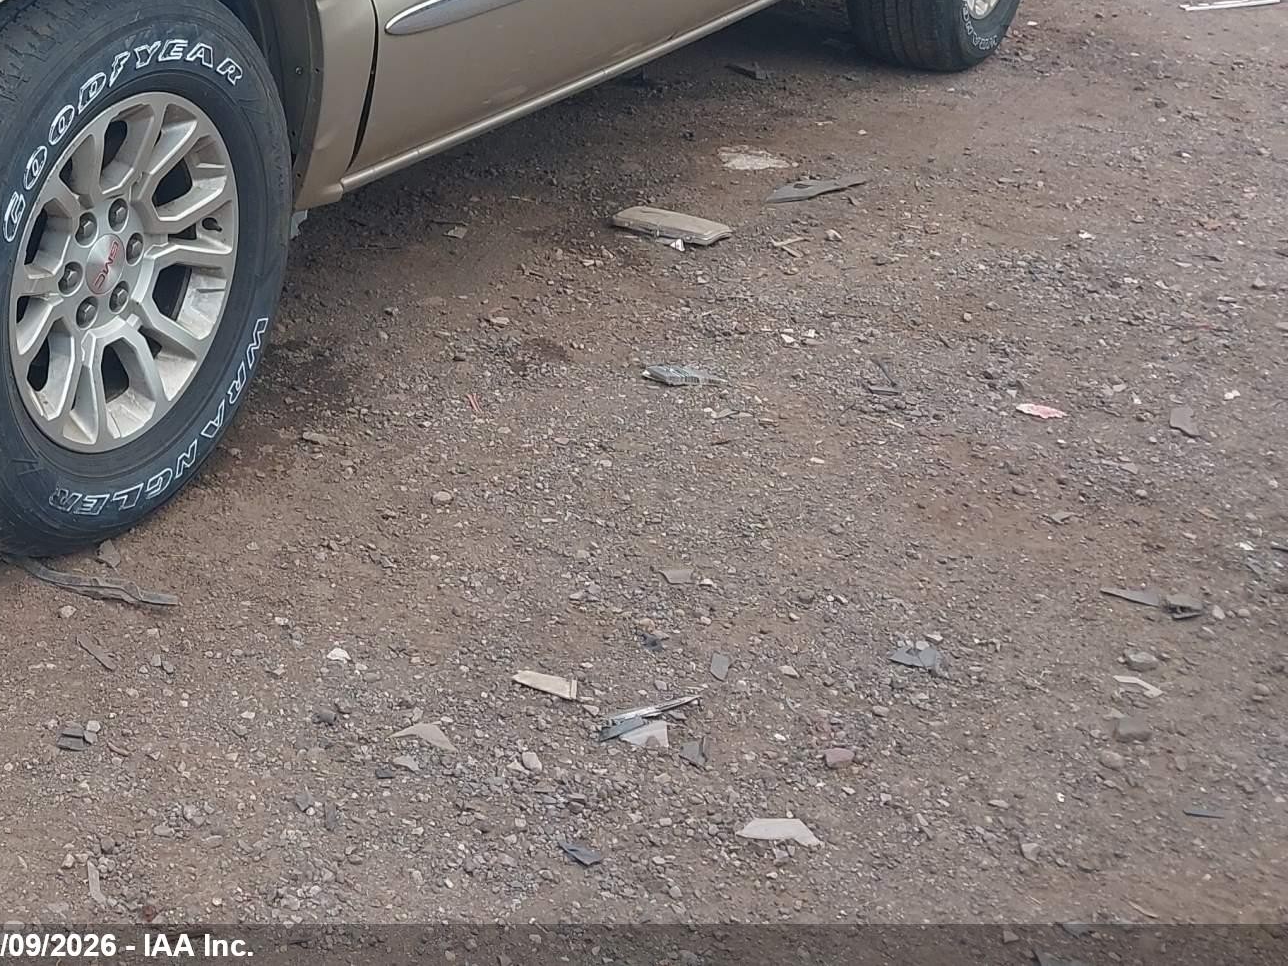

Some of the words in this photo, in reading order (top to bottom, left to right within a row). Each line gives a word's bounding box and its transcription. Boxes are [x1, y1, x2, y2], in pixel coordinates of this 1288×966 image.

[1, 38, 244, 243] GOODYEAR
[94, 239, 119, 290] GMC
[48, 316, 270, 518] WRANGLER
